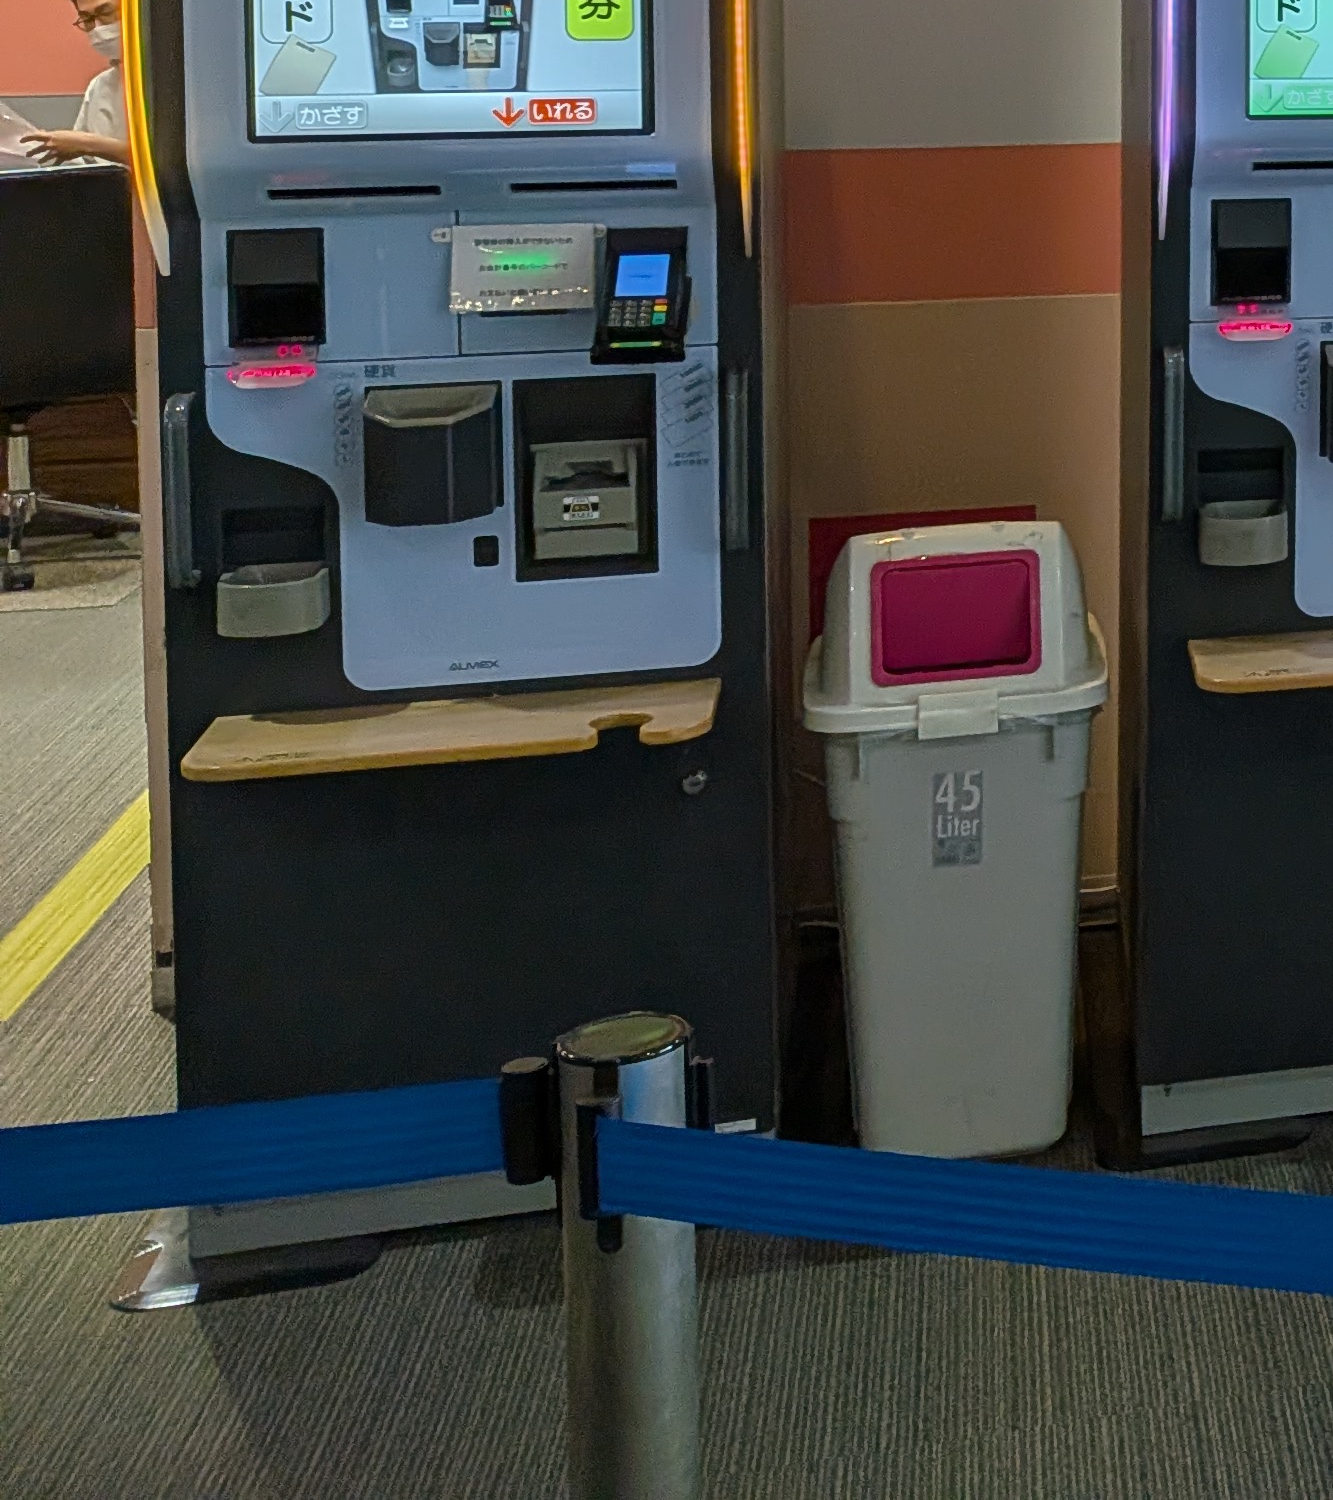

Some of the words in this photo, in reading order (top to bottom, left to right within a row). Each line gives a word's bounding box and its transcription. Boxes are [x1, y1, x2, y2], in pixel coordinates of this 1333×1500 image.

[299, 105, 364, 125] かざす
[532, 102, 594, 122] いれる
[935, 770, 982, 813] 45
[937, 815, 980, 838] Liter
